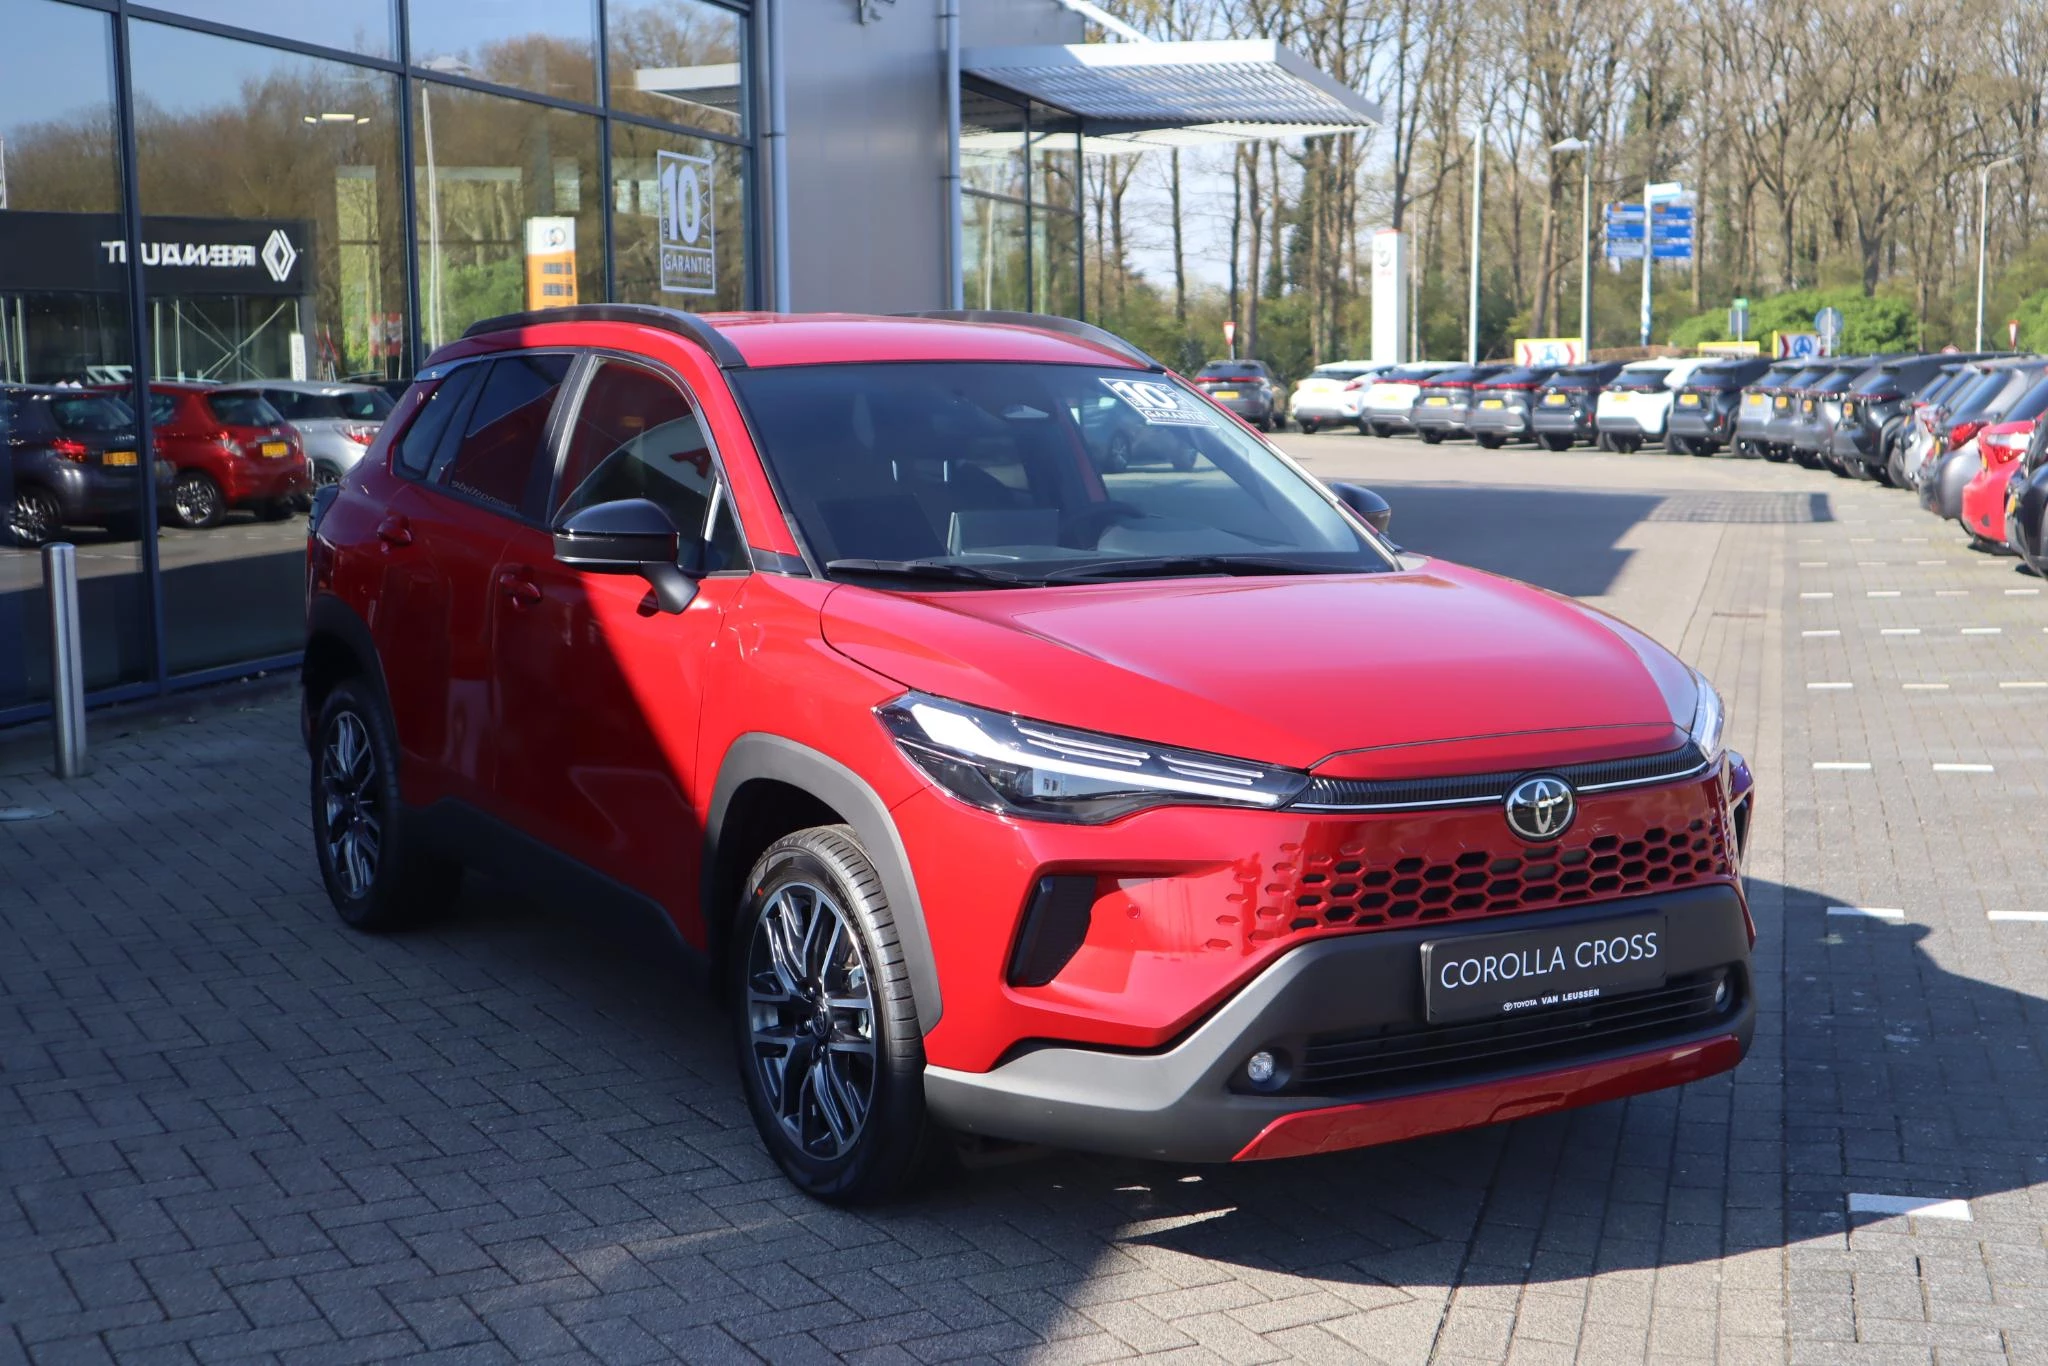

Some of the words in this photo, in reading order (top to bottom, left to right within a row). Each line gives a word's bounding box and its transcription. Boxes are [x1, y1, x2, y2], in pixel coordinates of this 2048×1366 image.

[662, 162, 701, 243] 10
[664, 254, 711, 275] GARANTIE
[1112, 381, 1178, 410] 10
[1440, 945, 1566, 989] COROLLA
[1574, 931, 1658, 968] CROSS
[1513, 999, 1538, 1009] TOYOTA
[1541, 995, 1559, 1005] VAN
[1562, 988, 1600, 1001] LEUSSEN
